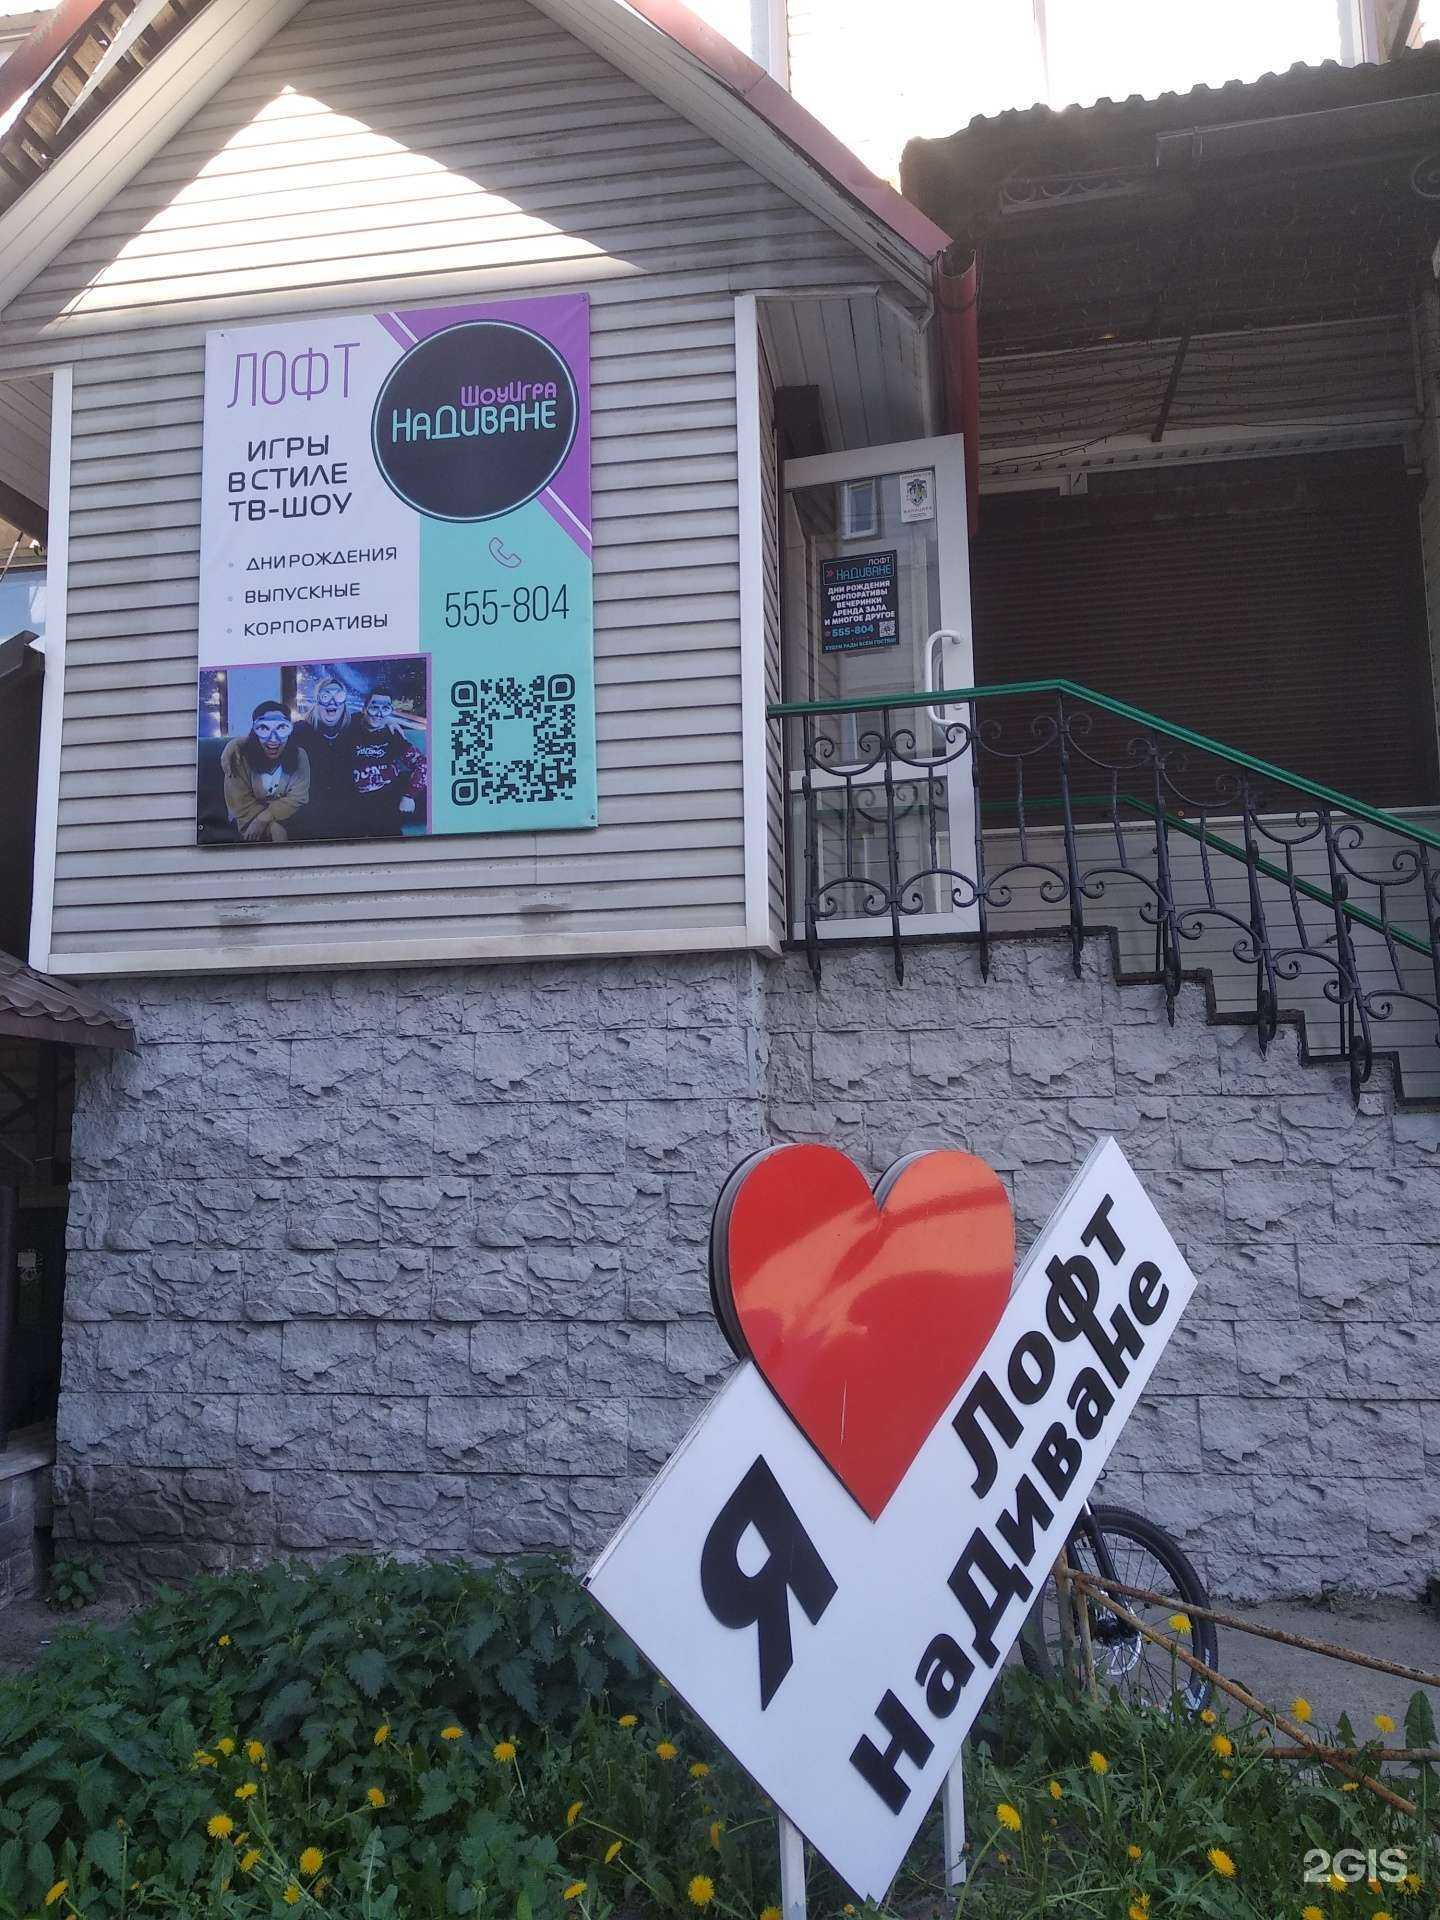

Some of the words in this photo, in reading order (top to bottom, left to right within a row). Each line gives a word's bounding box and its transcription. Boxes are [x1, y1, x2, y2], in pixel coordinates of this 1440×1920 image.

[227, 342, 361, 408] ЛОФТ
[248, 435, 329, 462] ИГРЫ
[228, 492, 352, 522] ТВ-ШОУ
[868, 556, 891, 566] ЛОФТ
[245, 582, 361, 604] ВЫПУСКНЫЕ
[827, 586, 845, 595] ДНИ
[846, 580, 891, 592] РОЖДЕНИЯ
[830, 588, 888, 602] КОРПОРАТИВЫ
[445, 584, 570, 628] 555-804
[832, 606, 864, 617] АРЕНДА
[865, 604, 887, 613] ЗАЛА
[836, 597, 882, 609] ВЕЧЕРИНКИ
[244, 613, 388, 637] КОРПОРАТИВЫ
[824, 618, 831, 626] И
[831, 615, 864, 625] МНОГОЕ
[865, 610, 896, 622] ДРУГОЕ
[831, 624, 875, 637] 555-804
[701, 1455, 838, 1711] Я
